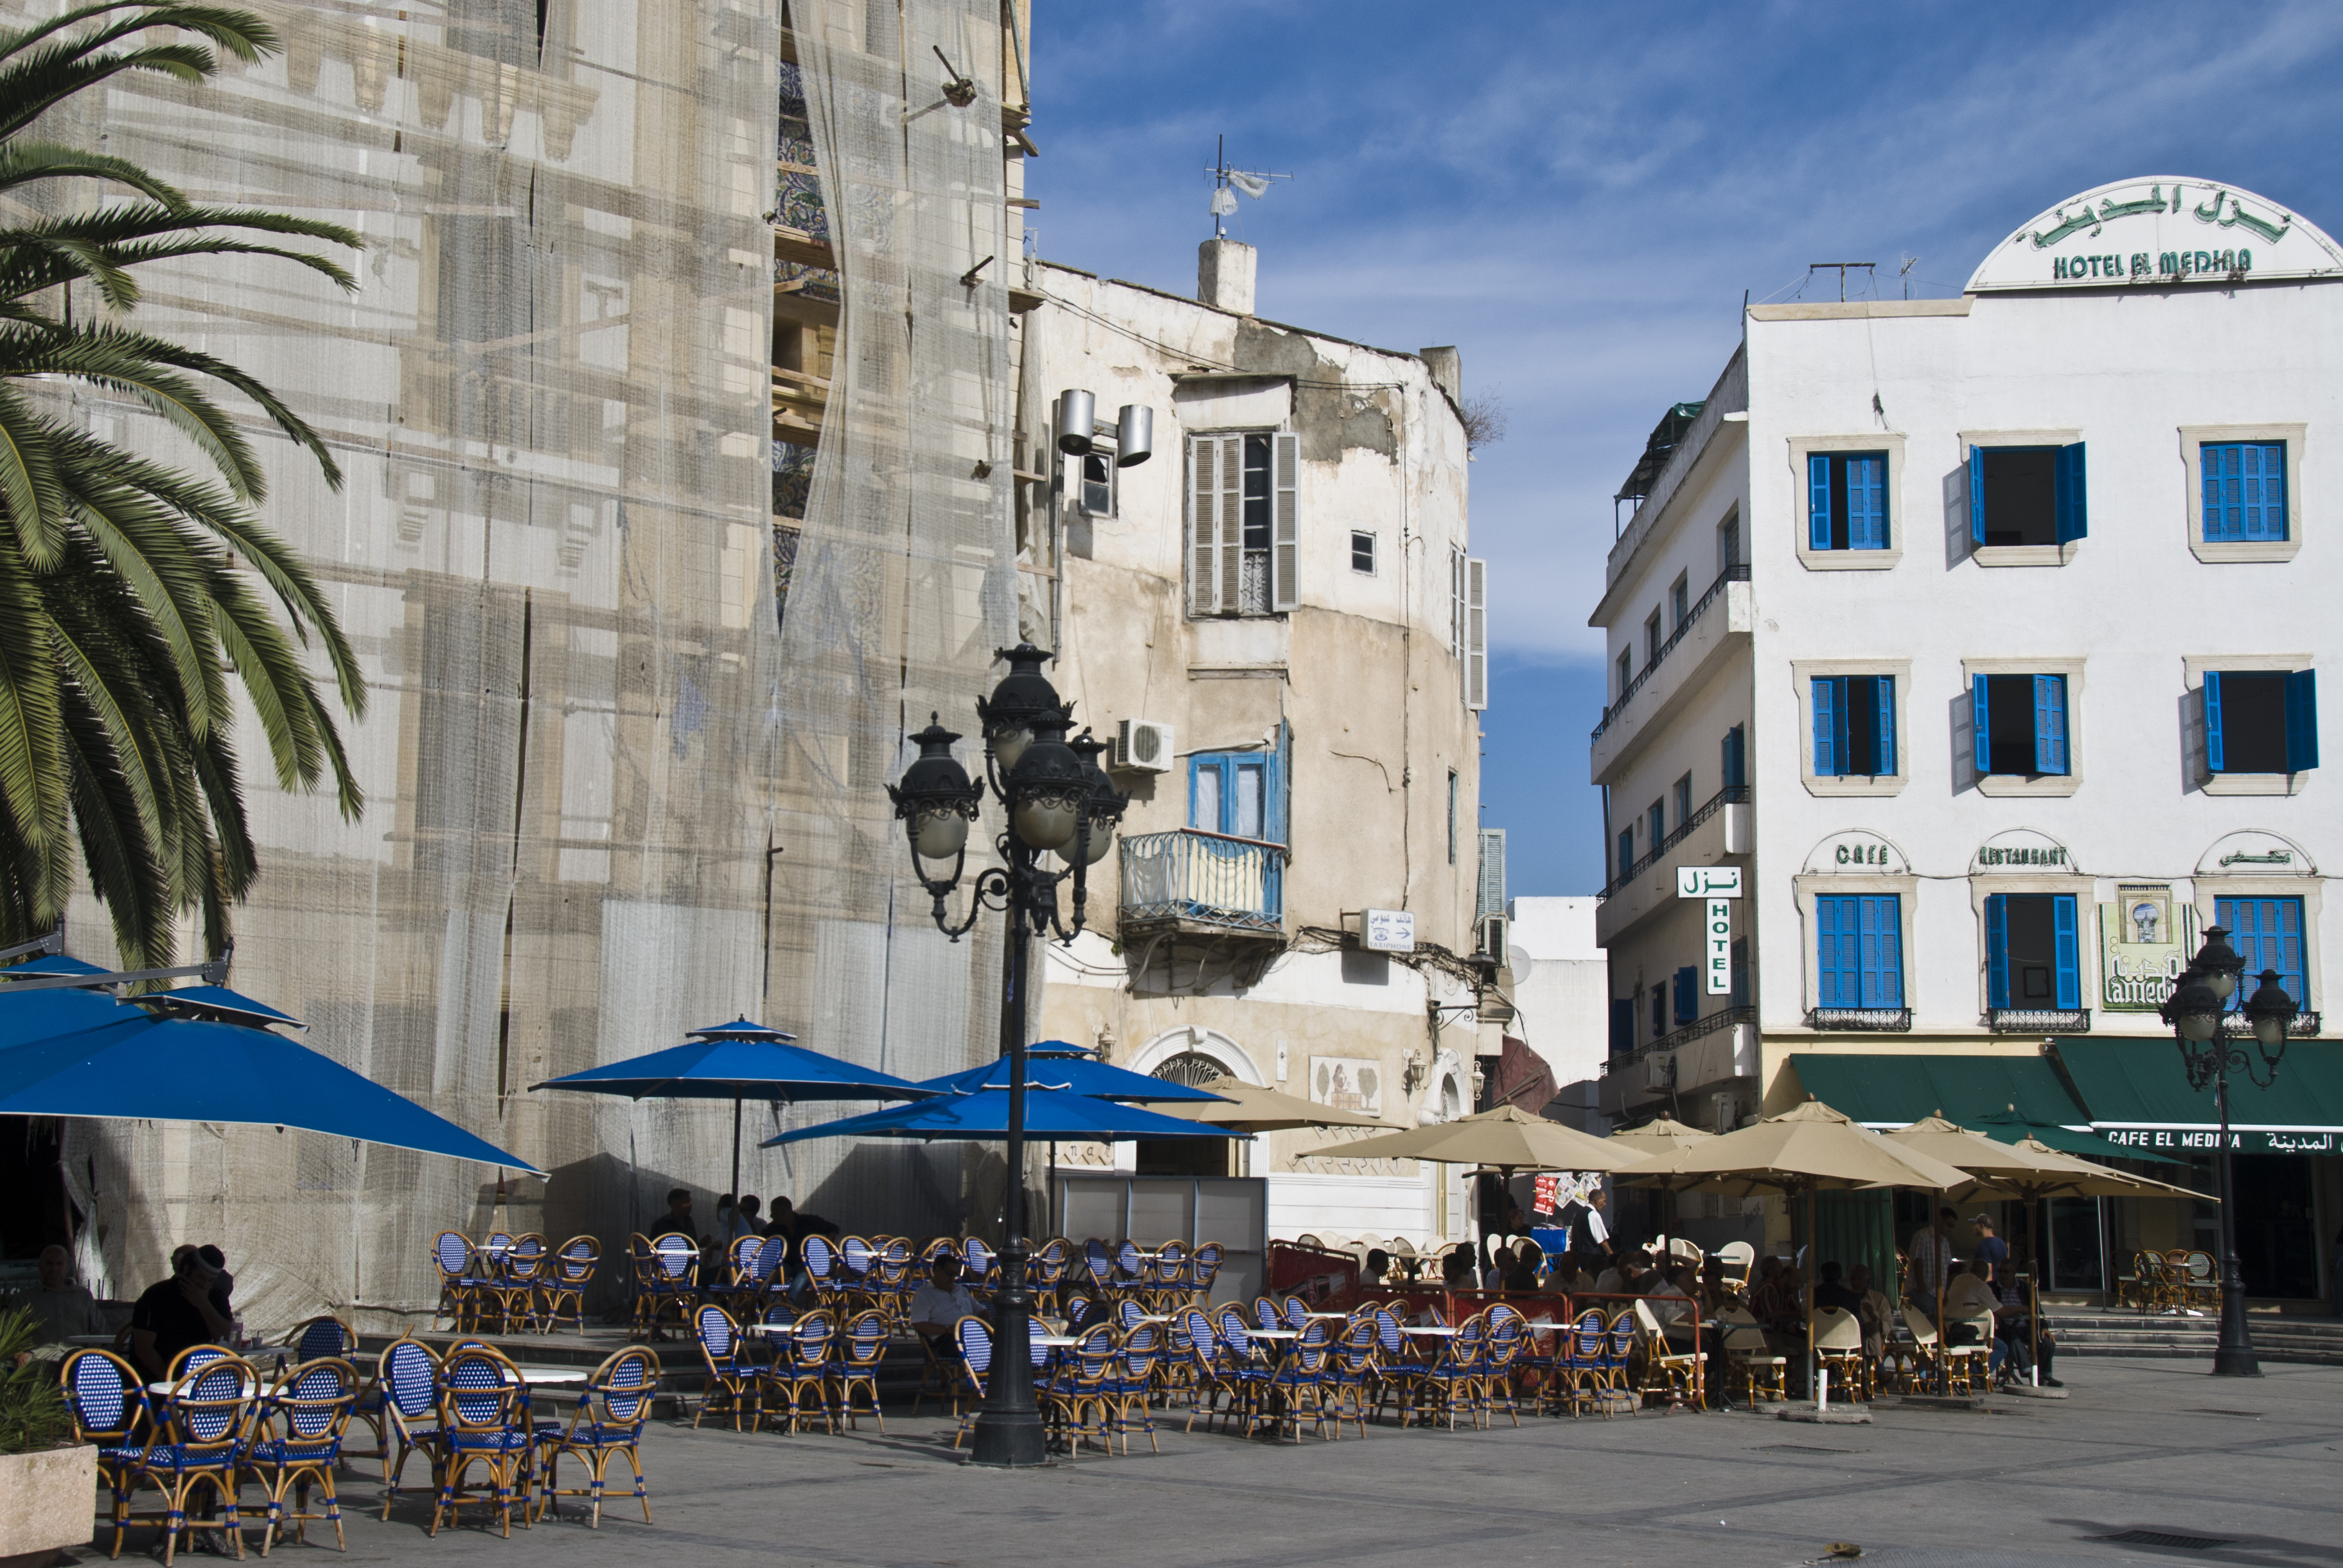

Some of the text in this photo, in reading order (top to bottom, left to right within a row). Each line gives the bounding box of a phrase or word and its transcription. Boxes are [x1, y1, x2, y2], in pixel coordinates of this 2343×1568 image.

[2193, 190, 2292, 245] نزل
[2053, 248, 2252, 279] HOTEL EL MEDINA
[1836, 844, 1888, 865] CAFE
[1978, 846, 2067, 867] RESTAURANT
[1684, 871, 1738, 894] نزل
[1369, 942, 1411, 951] TAXIPHONE
[1712, 904, 1729, 988] HOTEL
[2108, 1131, 2241, 1148] CAFE EL MEDIA
[2267, 1132, 2332, 1153] المدينة
